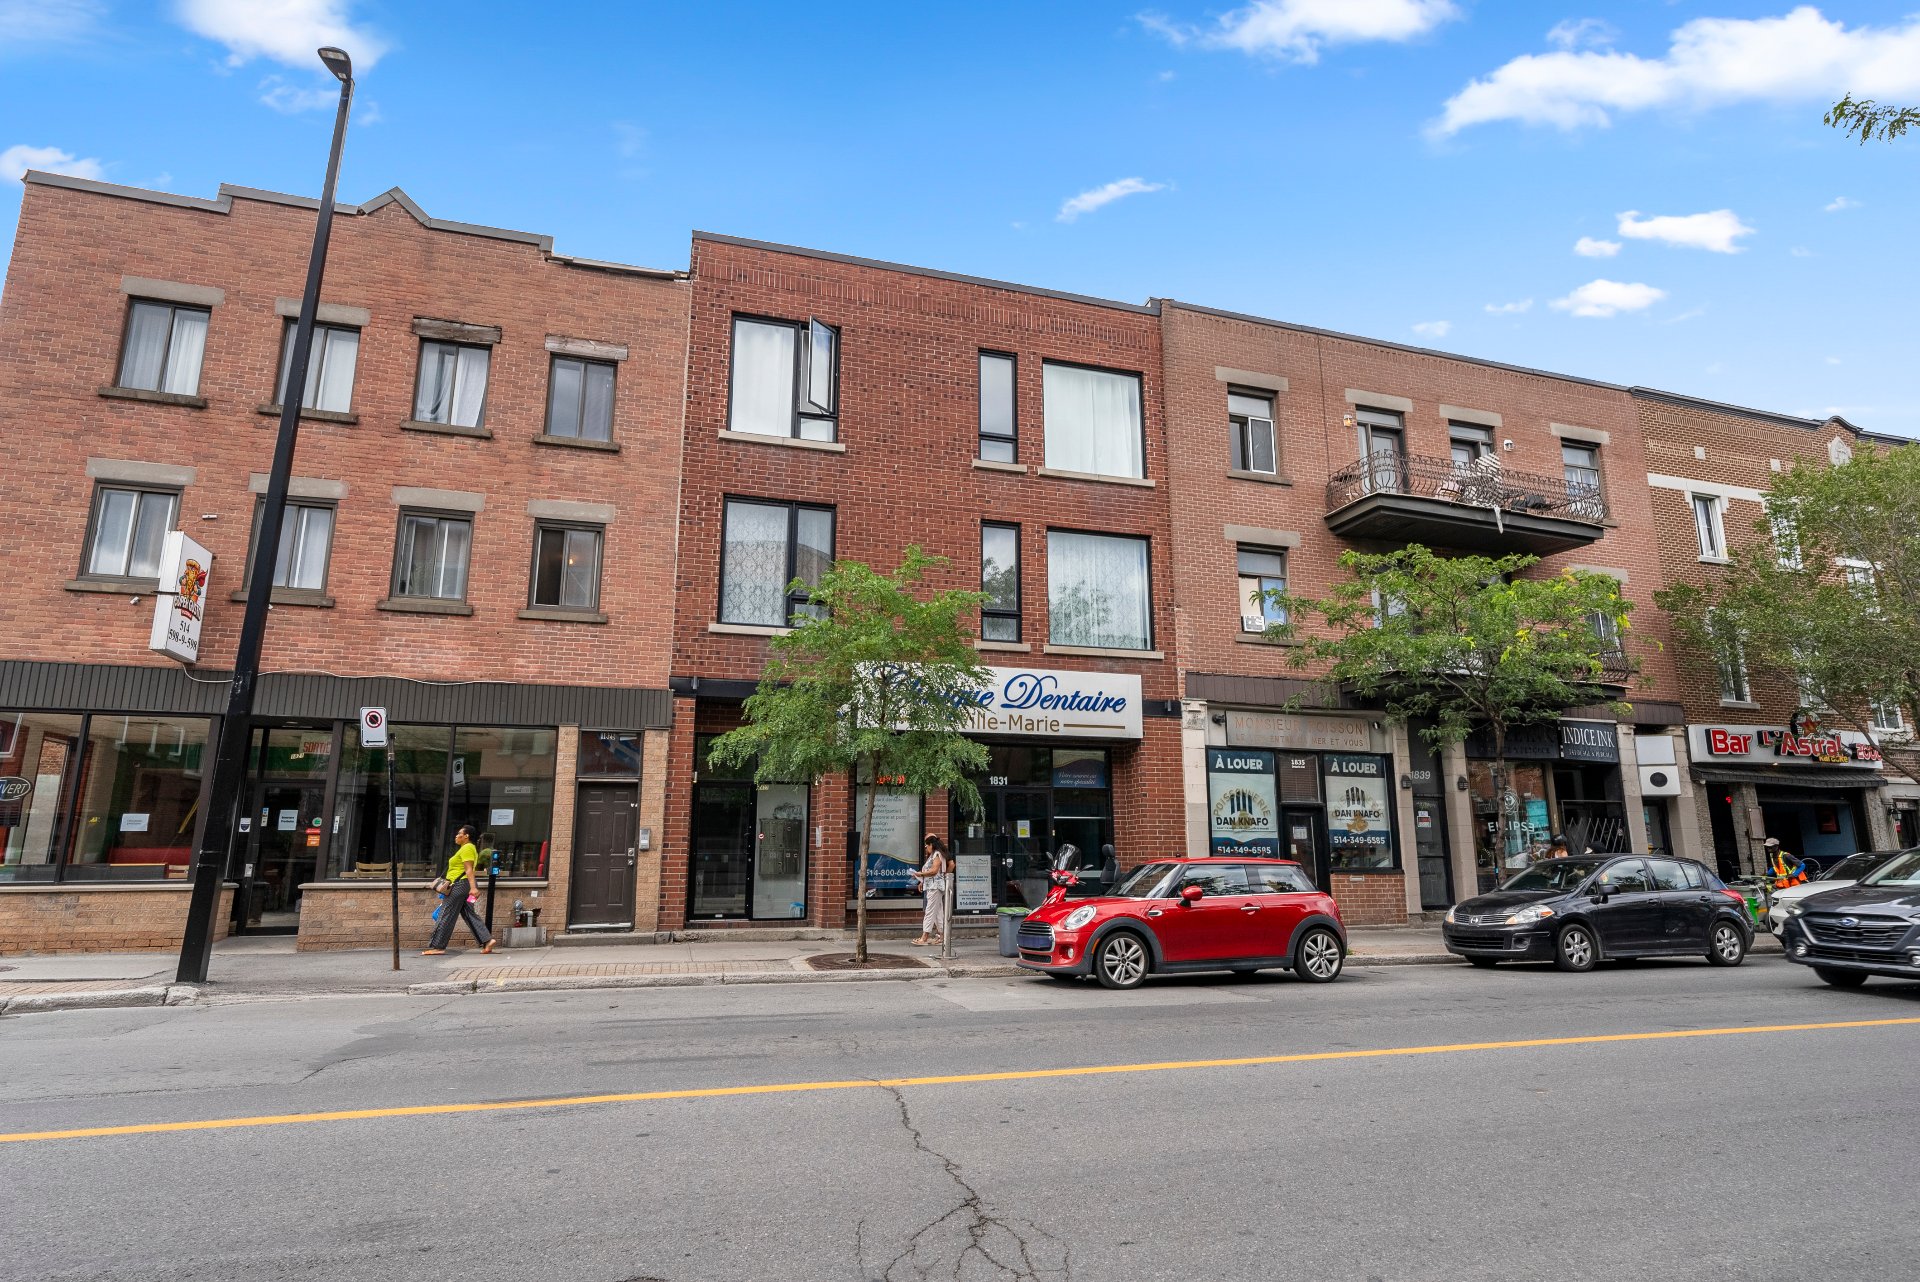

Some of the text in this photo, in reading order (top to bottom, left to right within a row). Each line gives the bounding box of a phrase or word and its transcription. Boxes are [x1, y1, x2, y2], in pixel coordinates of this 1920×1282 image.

[179, 620, 191, 634] 514
[168, 628, 198, 652] 598-9-598
[999, 673, 1127, 713] Dentaire
[1234, 716, 1364, 736] MONSIEUR POISSON
[1312, 736, 1327, 745] MER
[1330, 737, 1340, 746] ET
[1344, 739, 1364, 747] VOUS
[1562, 726, 1597, 746] INDICE
[1596, 729, 1616, 748] INK
[1709, 727, 1753, 755] Bar
[1761, 729, 1842, 757] L'Astral
[1215, 754, 1264, 771] À LOUER
[1330, 757, 1378, 774] À LOUER
[989, 775, 1009, 786] 1831
[1411, 770, 1431, 780] 1839
[0, 783, 28, 794] VERT
[1334, 809, 1380, 819] DAN KNAFO
[1215, 816, 1269, 827] DAN KNAFO
[1333, 835, 1386, 845] 514-349-6585
[1217, 846, 1272, 855] 514-349-6585
